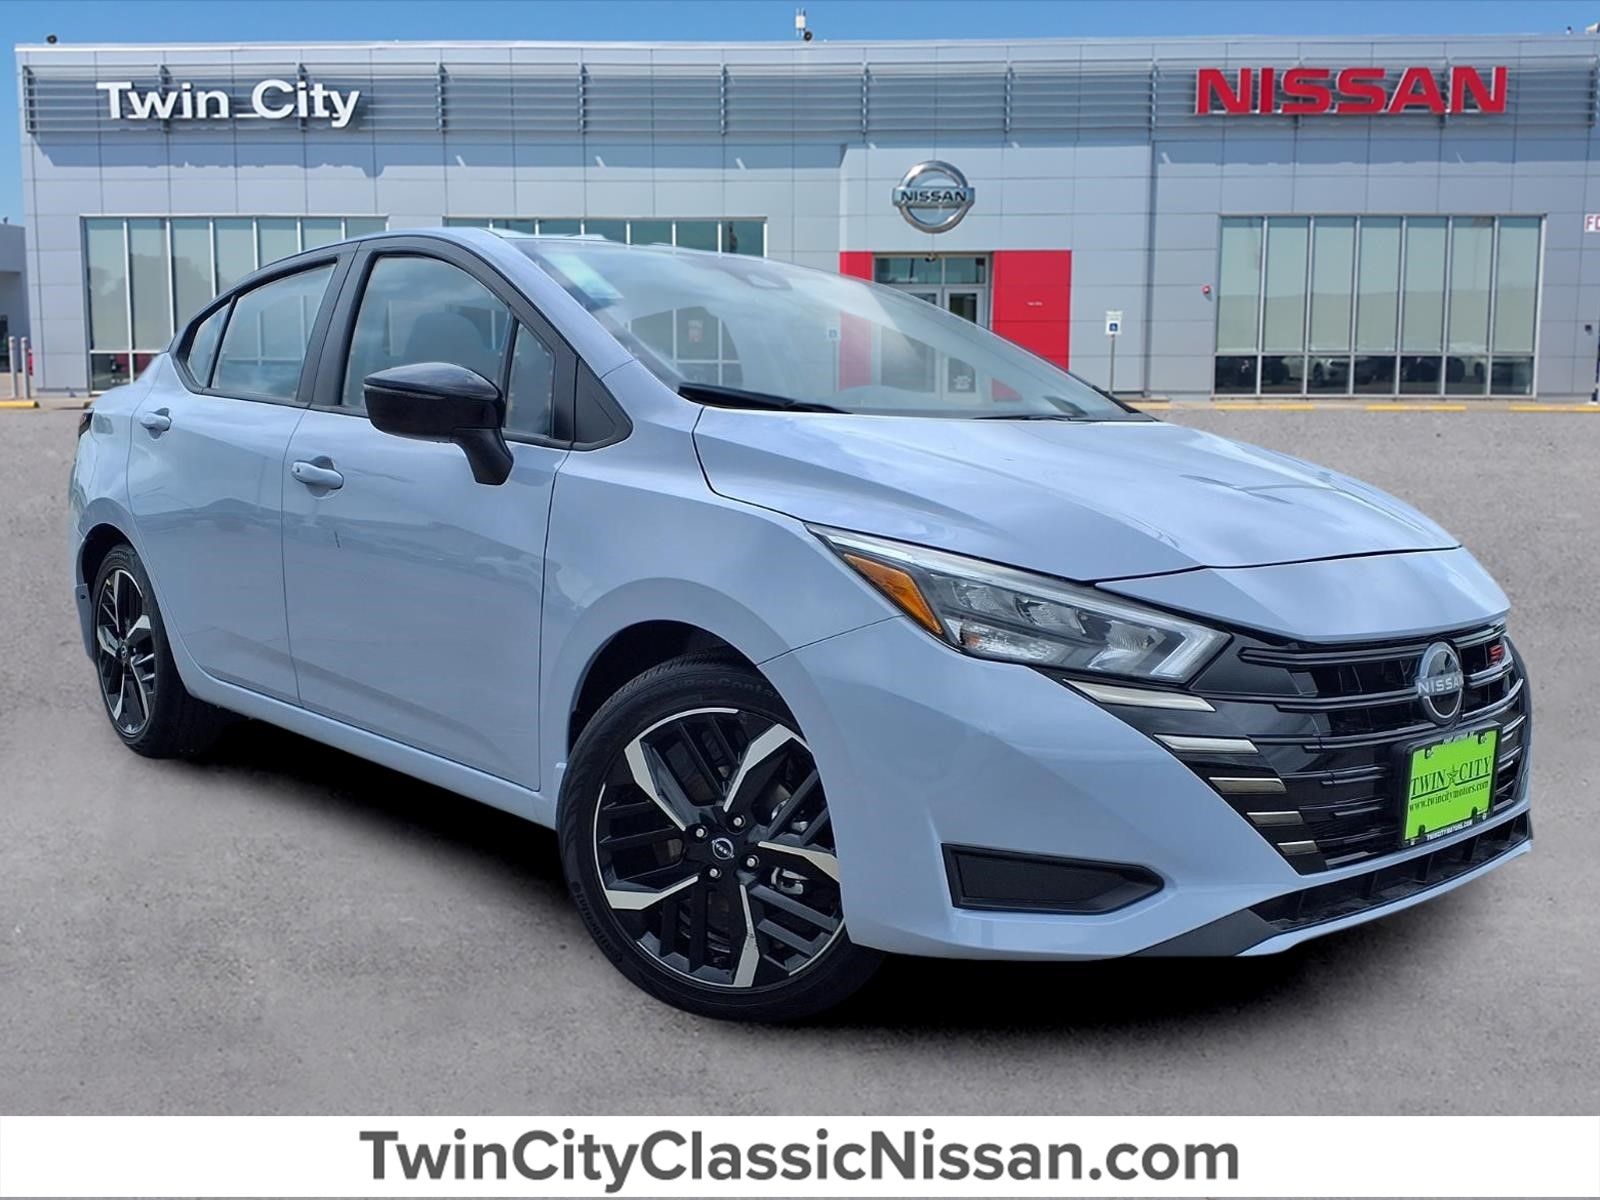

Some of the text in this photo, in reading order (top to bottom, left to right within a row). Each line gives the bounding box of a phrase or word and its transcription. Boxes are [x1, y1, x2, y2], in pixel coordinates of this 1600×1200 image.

[96, 79, 361, 128] Twin City
[1195, 66, 1509, 115] NISSAN
[901, 190, 967, 202] NISSAN
[1410, 755, 1492, 796] TWIN CITY
